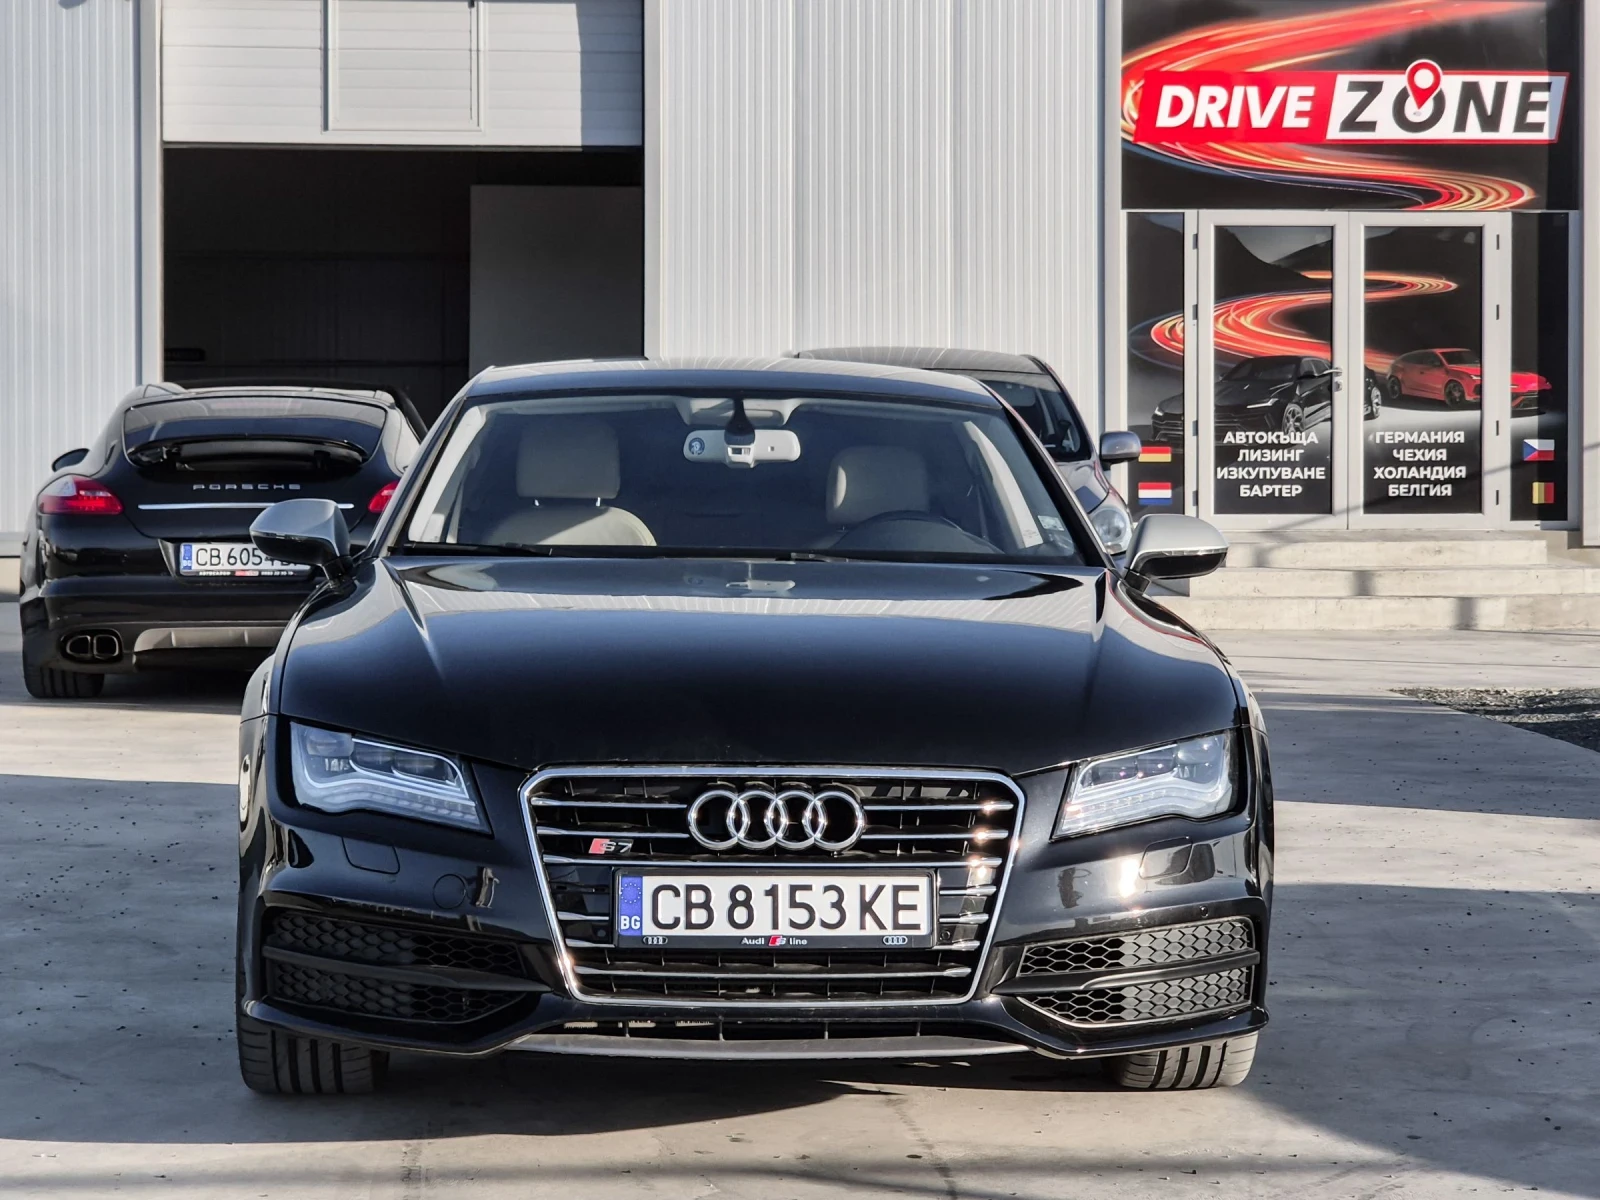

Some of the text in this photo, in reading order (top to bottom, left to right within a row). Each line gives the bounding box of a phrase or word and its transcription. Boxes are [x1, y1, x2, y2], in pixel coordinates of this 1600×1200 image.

[1155, 80, 1552, 133] DRIVE ZONE
[1223, 431, 1318, 446] АВТОКЪЩА
[1375, 431, 1465, 443] ГЕРМАНИЯ
[1237, 449, 1305, 461] ЛИЗИНГ
[1392, 449, 1447, 461] ЧЕХИЯ
[1216, 467, 1326, 479] ИЗКУПУВАНЕ
[1373, 466, 1467, 480] ХОЛАНДИЯ
[1239, 484, 1303, 497] БАРТЕР
[1388, 484, 1452, 497] БЕЛГИЯ
[196, 548, 221, 566] CB
[596, 840, 633, 853] S7
[651, 884, 921, 930] CB 8153 KE
[621, 915, 641, 929] BG
[741, 937, 765, 945] Audi
[789, 937, 808, 945] line
